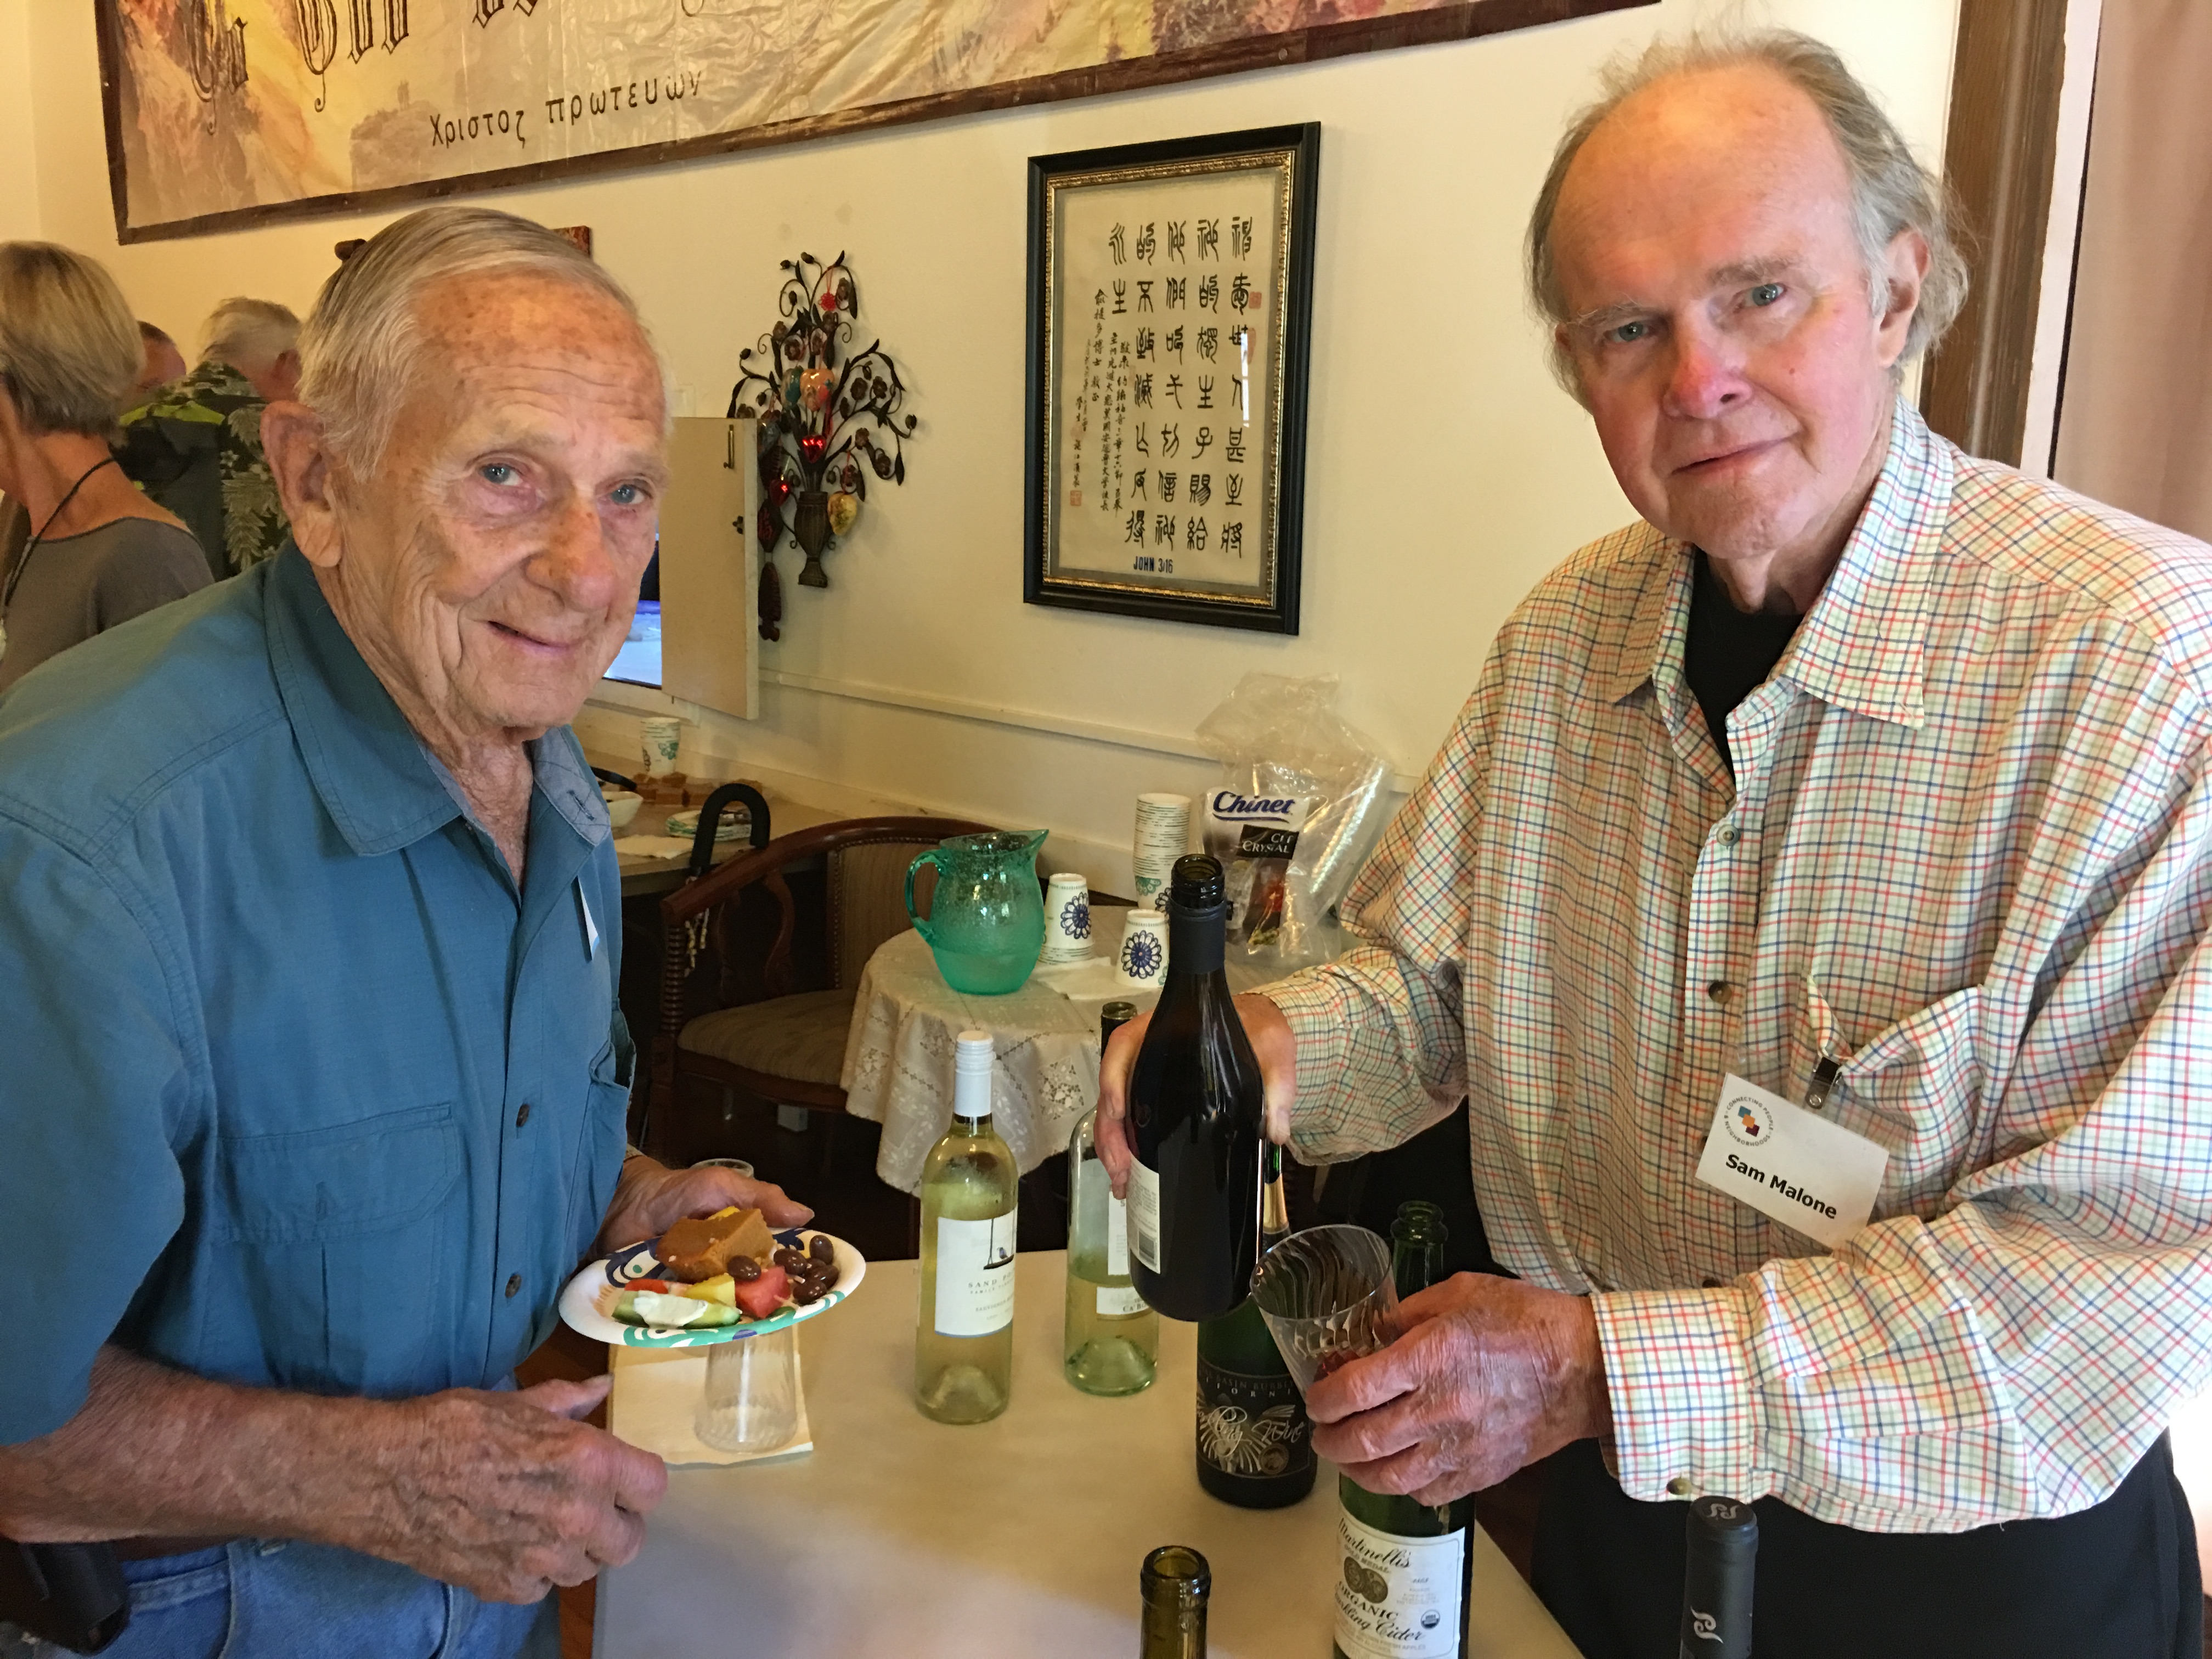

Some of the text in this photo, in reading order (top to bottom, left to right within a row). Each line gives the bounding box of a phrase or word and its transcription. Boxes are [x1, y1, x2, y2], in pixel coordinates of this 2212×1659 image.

[1133, 556, 1154, 572] JOHN
[1213, 791, 1295, 815] Chinet
[1726, 1096, 1774, 1131] CONNECTING PEOPLE
[1725, 1121, 1770, 1147] NEIGHBORHOODS
[1725, 1154, 1837, 1220] Sam Malone
[968, 1279, 997, 1288] SAND
[1338, 1517, 1412, 1568] Martinelli's
[1339, 1581, 1398, 1621] ORGANIC
[1375, 1619, 1426, 1641] Cider
